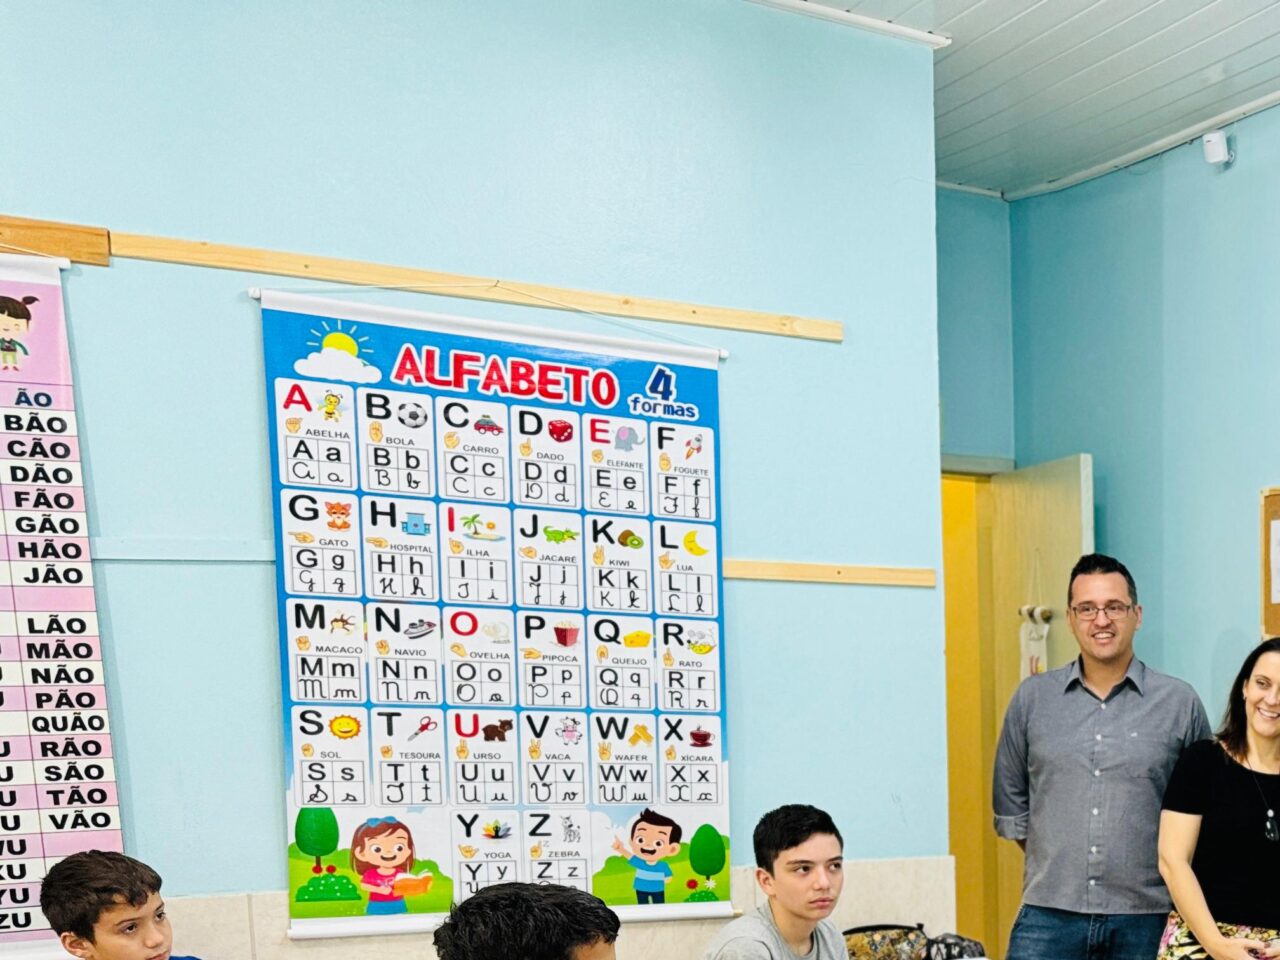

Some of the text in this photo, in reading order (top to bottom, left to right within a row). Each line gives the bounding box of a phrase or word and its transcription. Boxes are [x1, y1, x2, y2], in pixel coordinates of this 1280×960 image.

[393, 345, 617, 406] ALFABETO
[648, 368, 674, 400] 4
[15, 388, 52, 407] ÃO
[284, 384, 312, 411] A
[366, 393, 391, 419] B
[631, 396, 696, 418] formas
[4, 412, 67, 434] BÃO
[444, 403, 469, 427] C
[519, 411, 542, 435] D
[306, 429, 350, 439] ABELHA
[386, 437, 414, 446] BOLA
[590, 419, 610, 443] E
[658, 427, 675, 449] F
[7, 437, 71, 459] CÃO
[293, 440, 341, 462] A a
[374, 448, 420, 469] B b
[463, 445, 499, 454] CARRO
[537, 452, 564, 461] DADO
[10, 462, 73, 484] DÃO
[450, 455, 495, 476] C c
[525, 462, 567, 483] D d
[607, 460, 643, 469] ELEFANTE
[597, 469, 636, 490] E e
[665, 476, 700, 495] F f
[14, 488, 75, 509] FÃO
[289, 495, 318, 521] G
[15, 512, 80, 535] GÃO
[371, 501, 396, 527] H
[448, 508, 454, 532] I
[520, 514, 538, 537] J
[593, 519, 614, 544] K
[319, 539, 348, 547] GATO
[661, 525, 678, 549] L
[18, 537, 82, 560] HÃO
[296, 549, 344, 570] G g
[390, 544, 433, 553] HOSPITAL
[467, 549, 489, 557] ILHA
[24, 562, 83, 585] JÃO
[378, 554, 423, 574] H h
[490, 562, 493, 579] i
[530, 565, 541, 582] J
[599, 570, 638, 588] K k
[669, 574, 680, 591] L
[27, 614, 87, 635] LÃO
[295, 604, 325, 629] M
[375, 607, 400, 632] N
[450, 612, 478, 636] O
[525, 616, 545, 638] P
[594, 619, 621, 644] Q
[663, 623, 683, 646] R
[26, 638, 93, 660] MÃO
[316, 646, 363, 654] MACACO
[541, 654, 578, 662] PIPOCA
[301, 657, 354, 677] M m
[383, 660, 427, 679] N n
[612, 657, 647, 665] QUEIJO
[31, 663, 94, 685] NÃO
[457, 663, 501, 682] O o
[532, 666, 573, 686] P p
[600, 669, 640, 687] Q q
[669, 671, 705, 688] R r
[35, 688, 96, 710] PÃO
[32, 711, 105, 734] QUÃO
[300, 710, 323, 735] S
[377, 712, 401, 736] T
[455, 714, 479, 737] U
[526, 715, 549, 738] V
[596, 717, 628, 739] W
[664, 719, 683, 741] X
[40, 737, 102, 758] RÃO
[44, 760, 105, 782] SÃO
[308, 763, 354, 781] S s
[387, 764, 429, 781] T t
[462, 764, 504, 781] U u
[533, 765, 575, 781] V v
[600, 765, 647, 781] W w
[671, 766, 709, 782] X x
[47, 786, 107, 807] TÃO
[49, 809, 111, 831] VÃO
[457, 814, 478, 837] Y
[529, 814, 551, 836] Z
[466, 864, 507, 880] Y y
[538, 862, 578, 878] Z z
